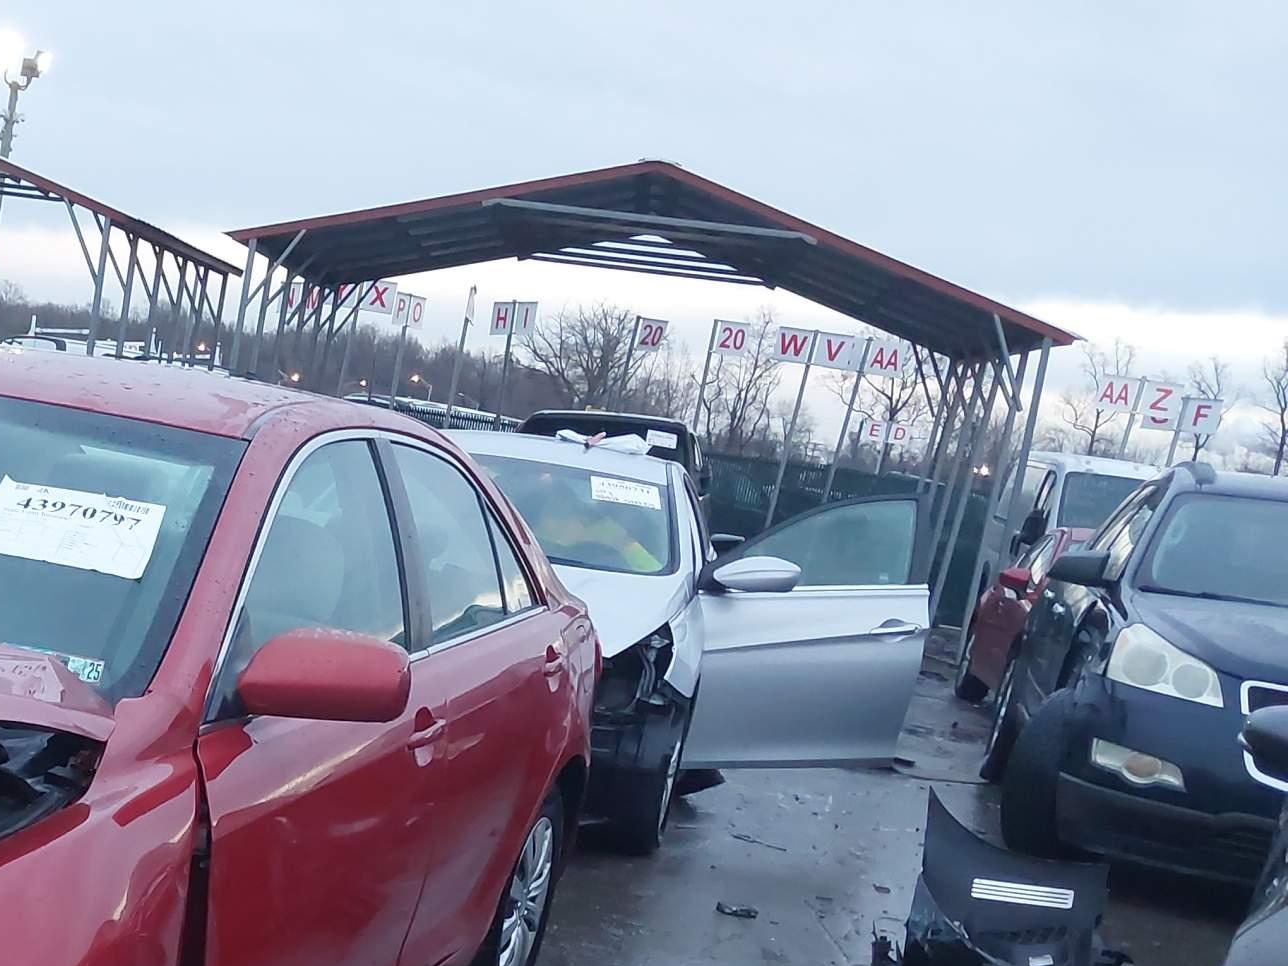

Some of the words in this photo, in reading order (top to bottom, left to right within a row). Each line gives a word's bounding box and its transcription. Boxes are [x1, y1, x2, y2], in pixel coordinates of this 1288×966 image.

[369, 285, 390, 308] X
[396, 298, 406, 319] P
[495, 307, 509, 329] H
[640, 324, 664, 347] 20
[718, 327, 746, 350] 20
[780, 333, 808, 357] W
[826, 338, 845, 362] V
[870, 347, 898, 372] AA
[1098, 382, 1128, 406] AA
[1150, 388, 1173, 412] Z
[1192, 404, 1212, 426] F
[868, 424, 882, 437] E
[894, 427, 906, 441] D
[16, 496, 142, 530] 43970797
[87, 662, 102, 680] 25
